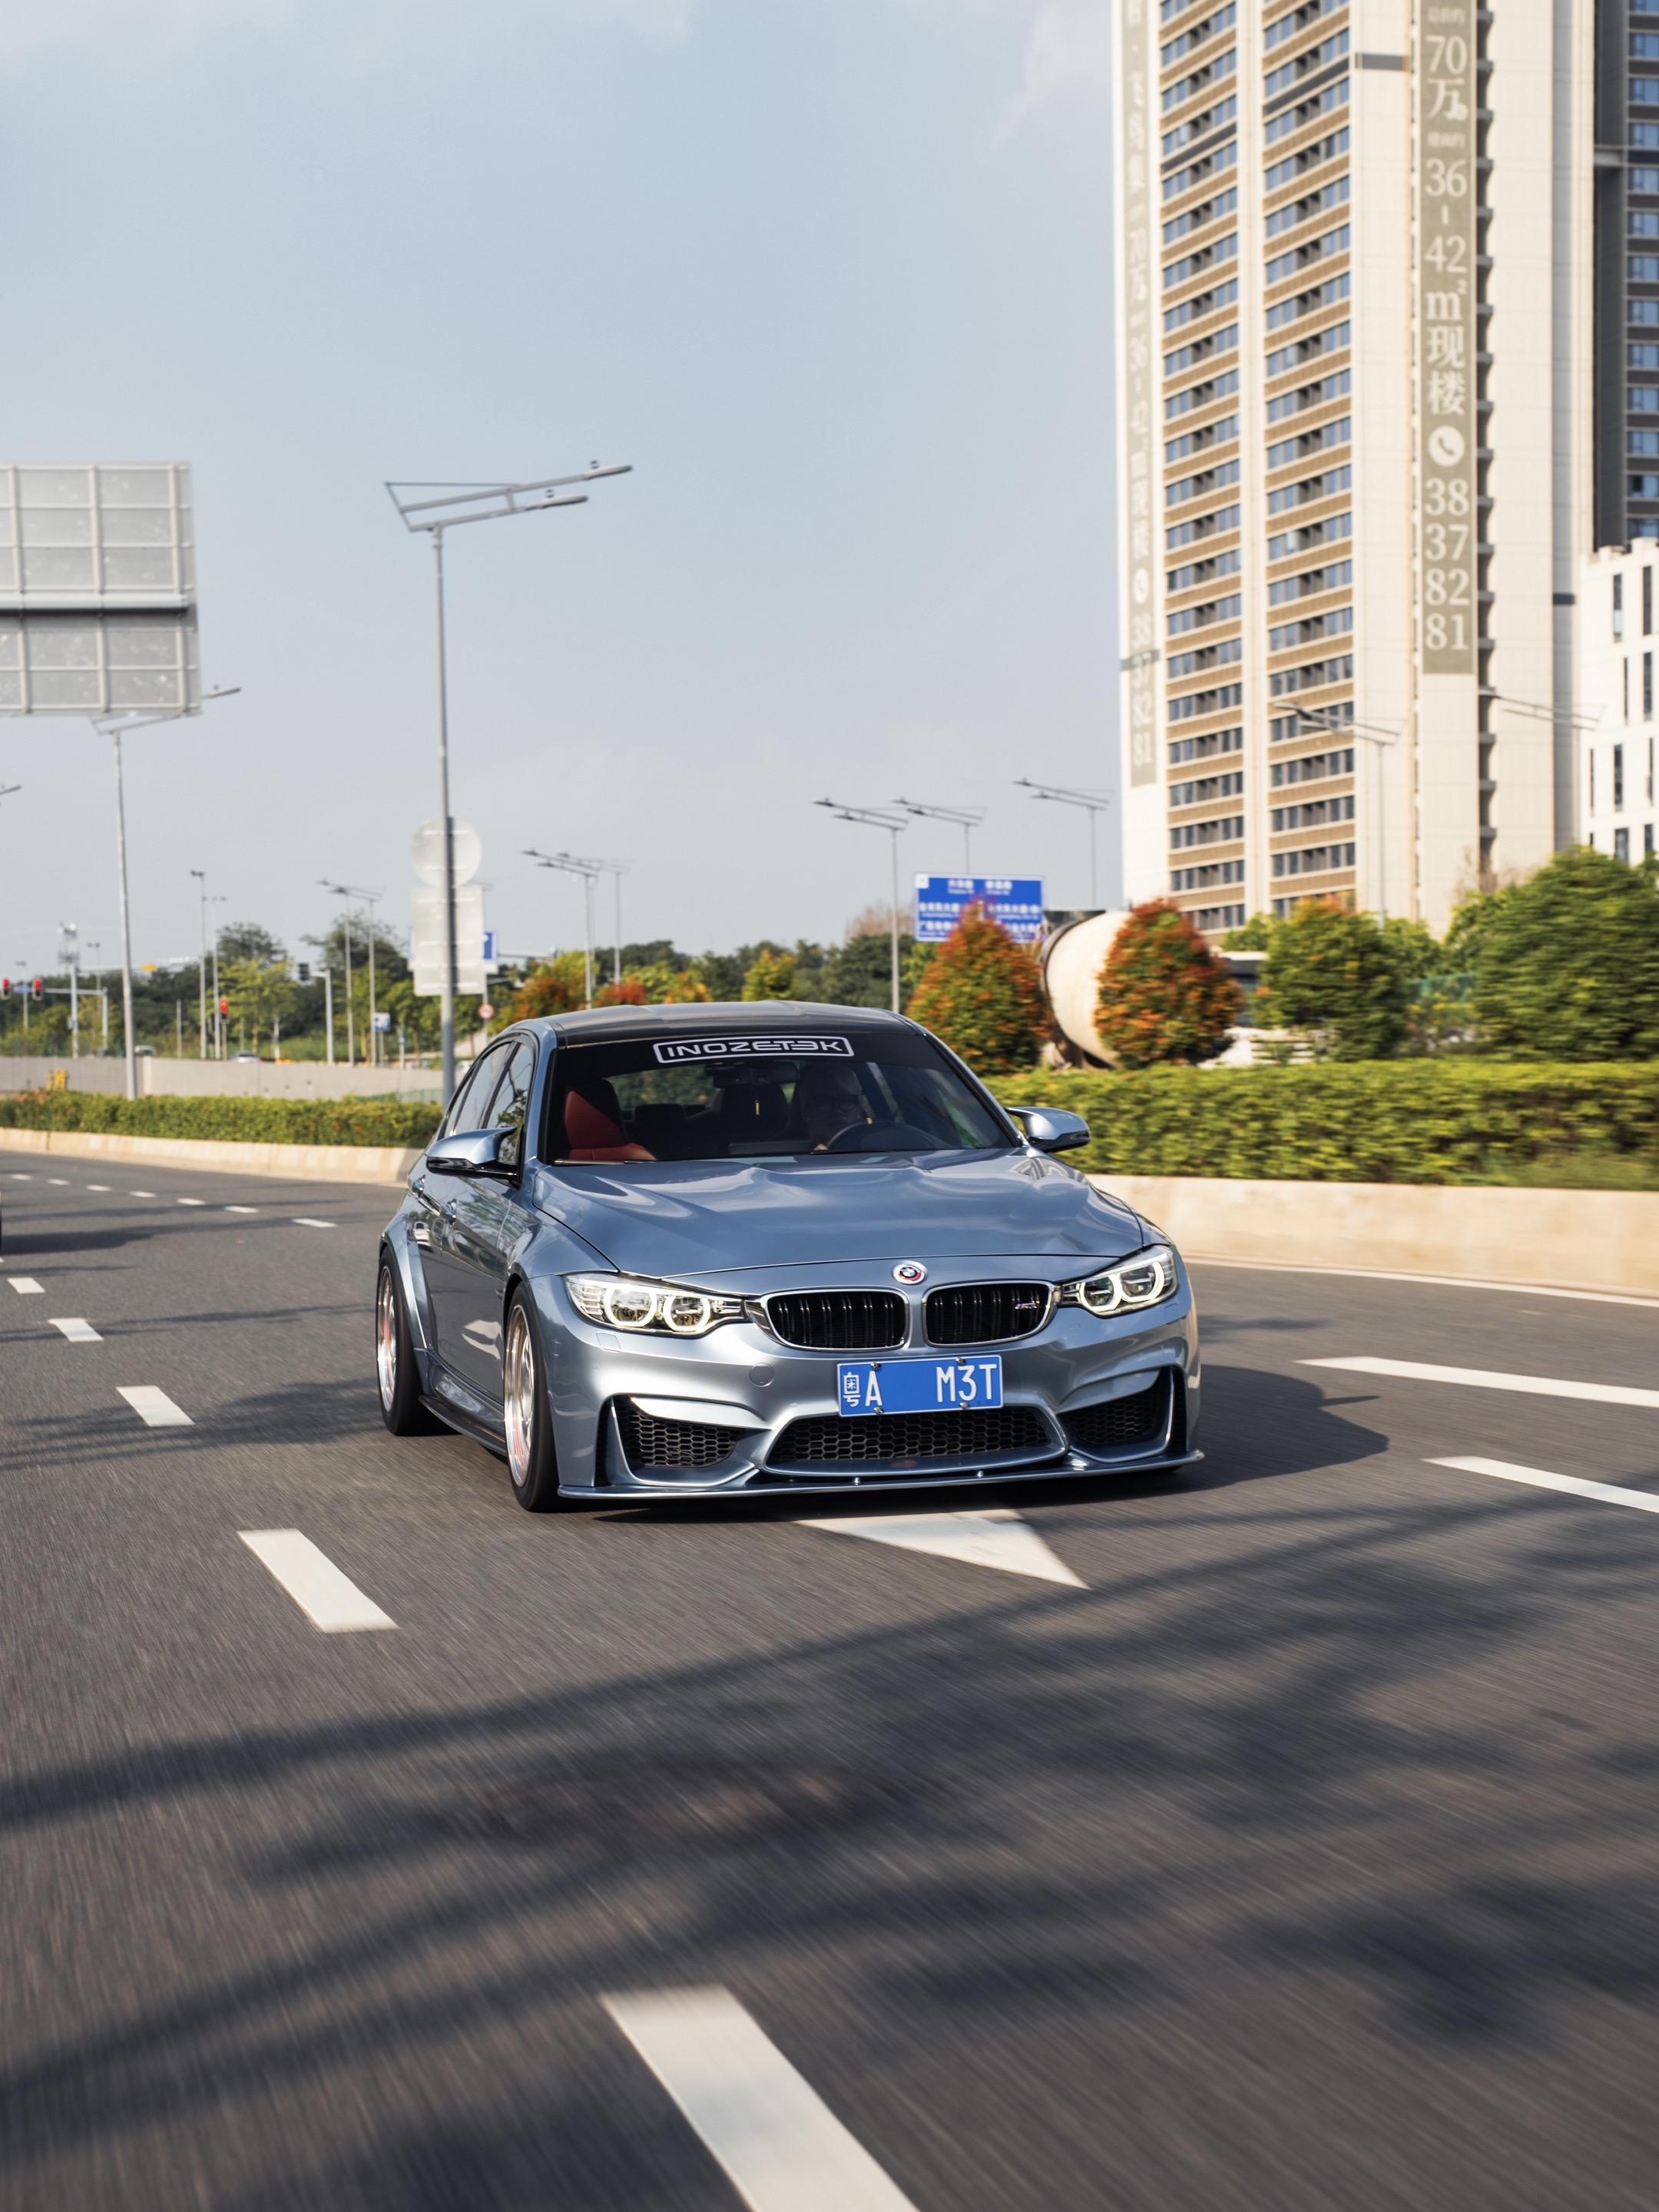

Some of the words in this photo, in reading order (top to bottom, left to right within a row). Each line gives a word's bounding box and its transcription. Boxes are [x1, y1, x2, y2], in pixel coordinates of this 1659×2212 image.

[1426, 35, 1467, 75] 70
[1426, 158, 1468, 197] 36
[1425, 234, 1468, 273] 42
[1424, 478, 1470, 516] 38
[1424, 522, 1470, 561] 37
[1425, 568, 1471, 605] 82
[1425, 613, 1470, 651] 81
[935, 1364, 997, 1402] M3T
